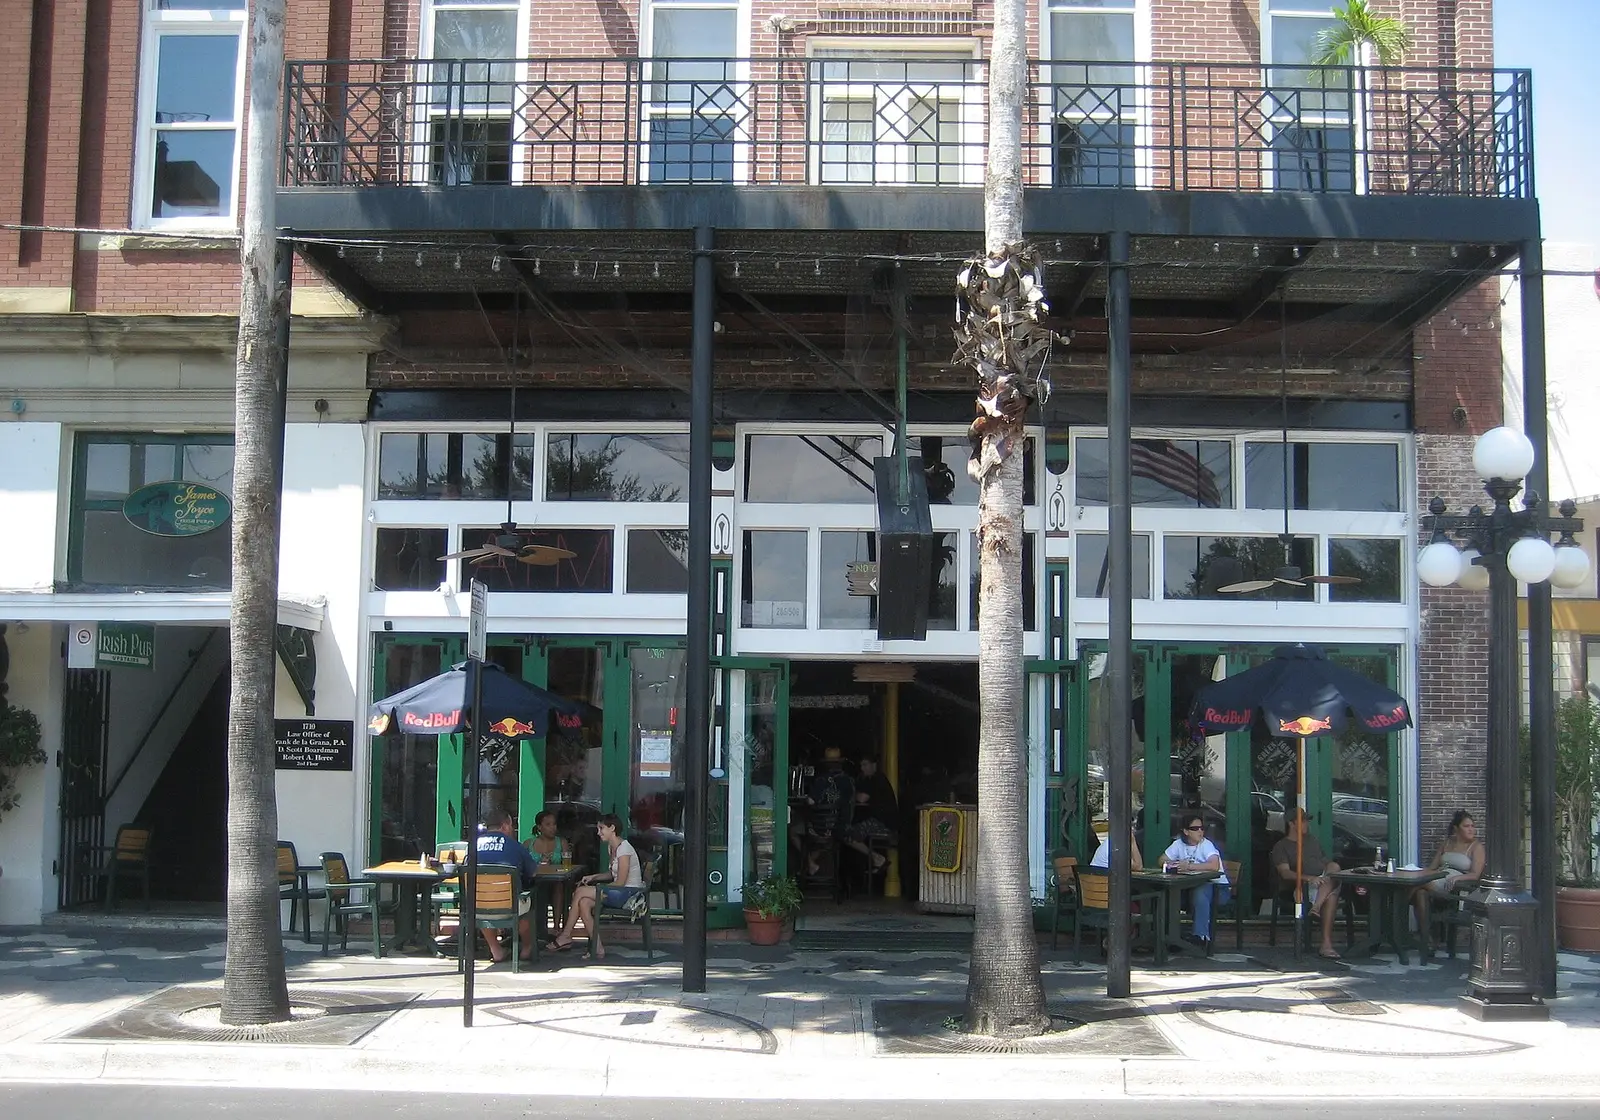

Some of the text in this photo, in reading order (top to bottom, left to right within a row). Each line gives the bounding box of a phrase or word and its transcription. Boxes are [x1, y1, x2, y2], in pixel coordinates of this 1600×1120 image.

[174, 485, 216, 504] James
[174, 500, 215, 519] Joyce
[304, 746, 339, 754] Boardman
